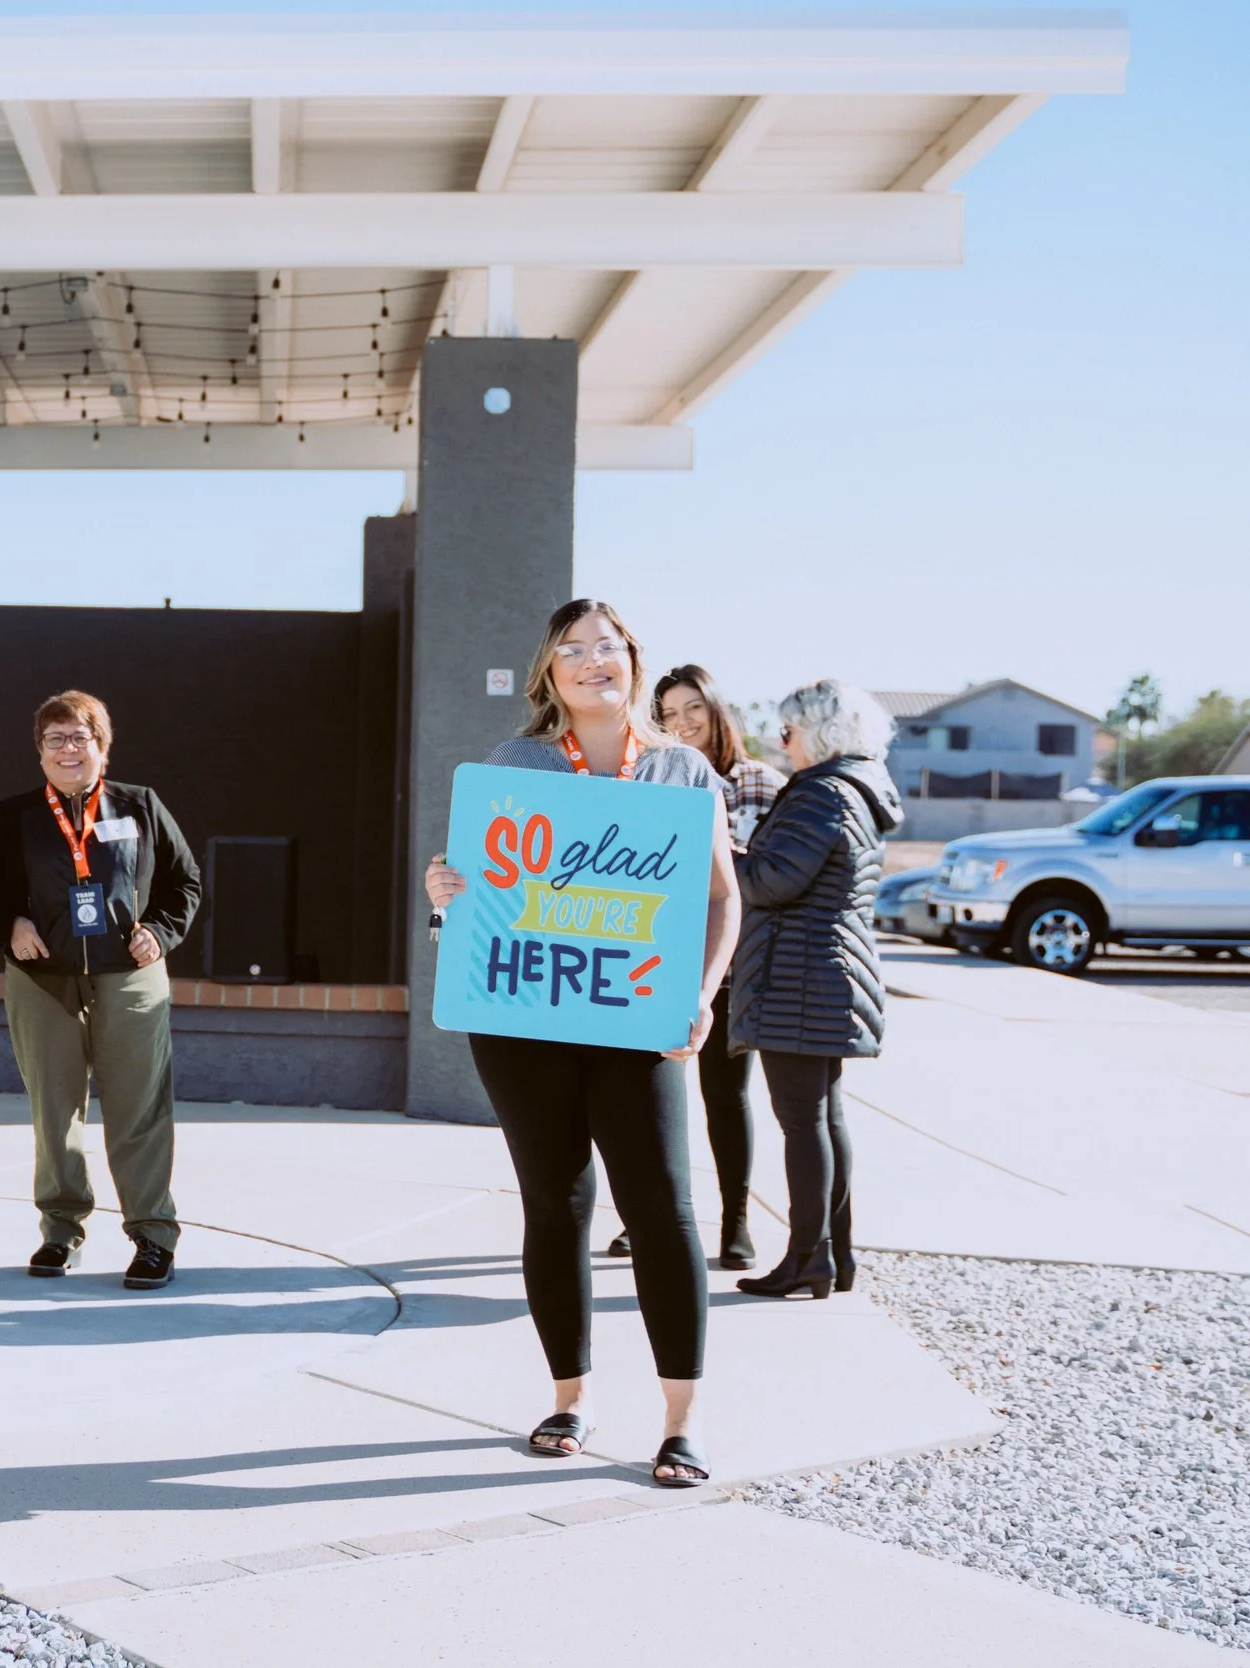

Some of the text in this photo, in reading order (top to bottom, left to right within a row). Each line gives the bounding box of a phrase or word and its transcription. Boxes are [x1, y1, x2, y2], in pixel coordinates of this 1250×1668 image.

[483, 813, 678, 890] SO glad
[536, 889, 643, 934] YOU'RE
